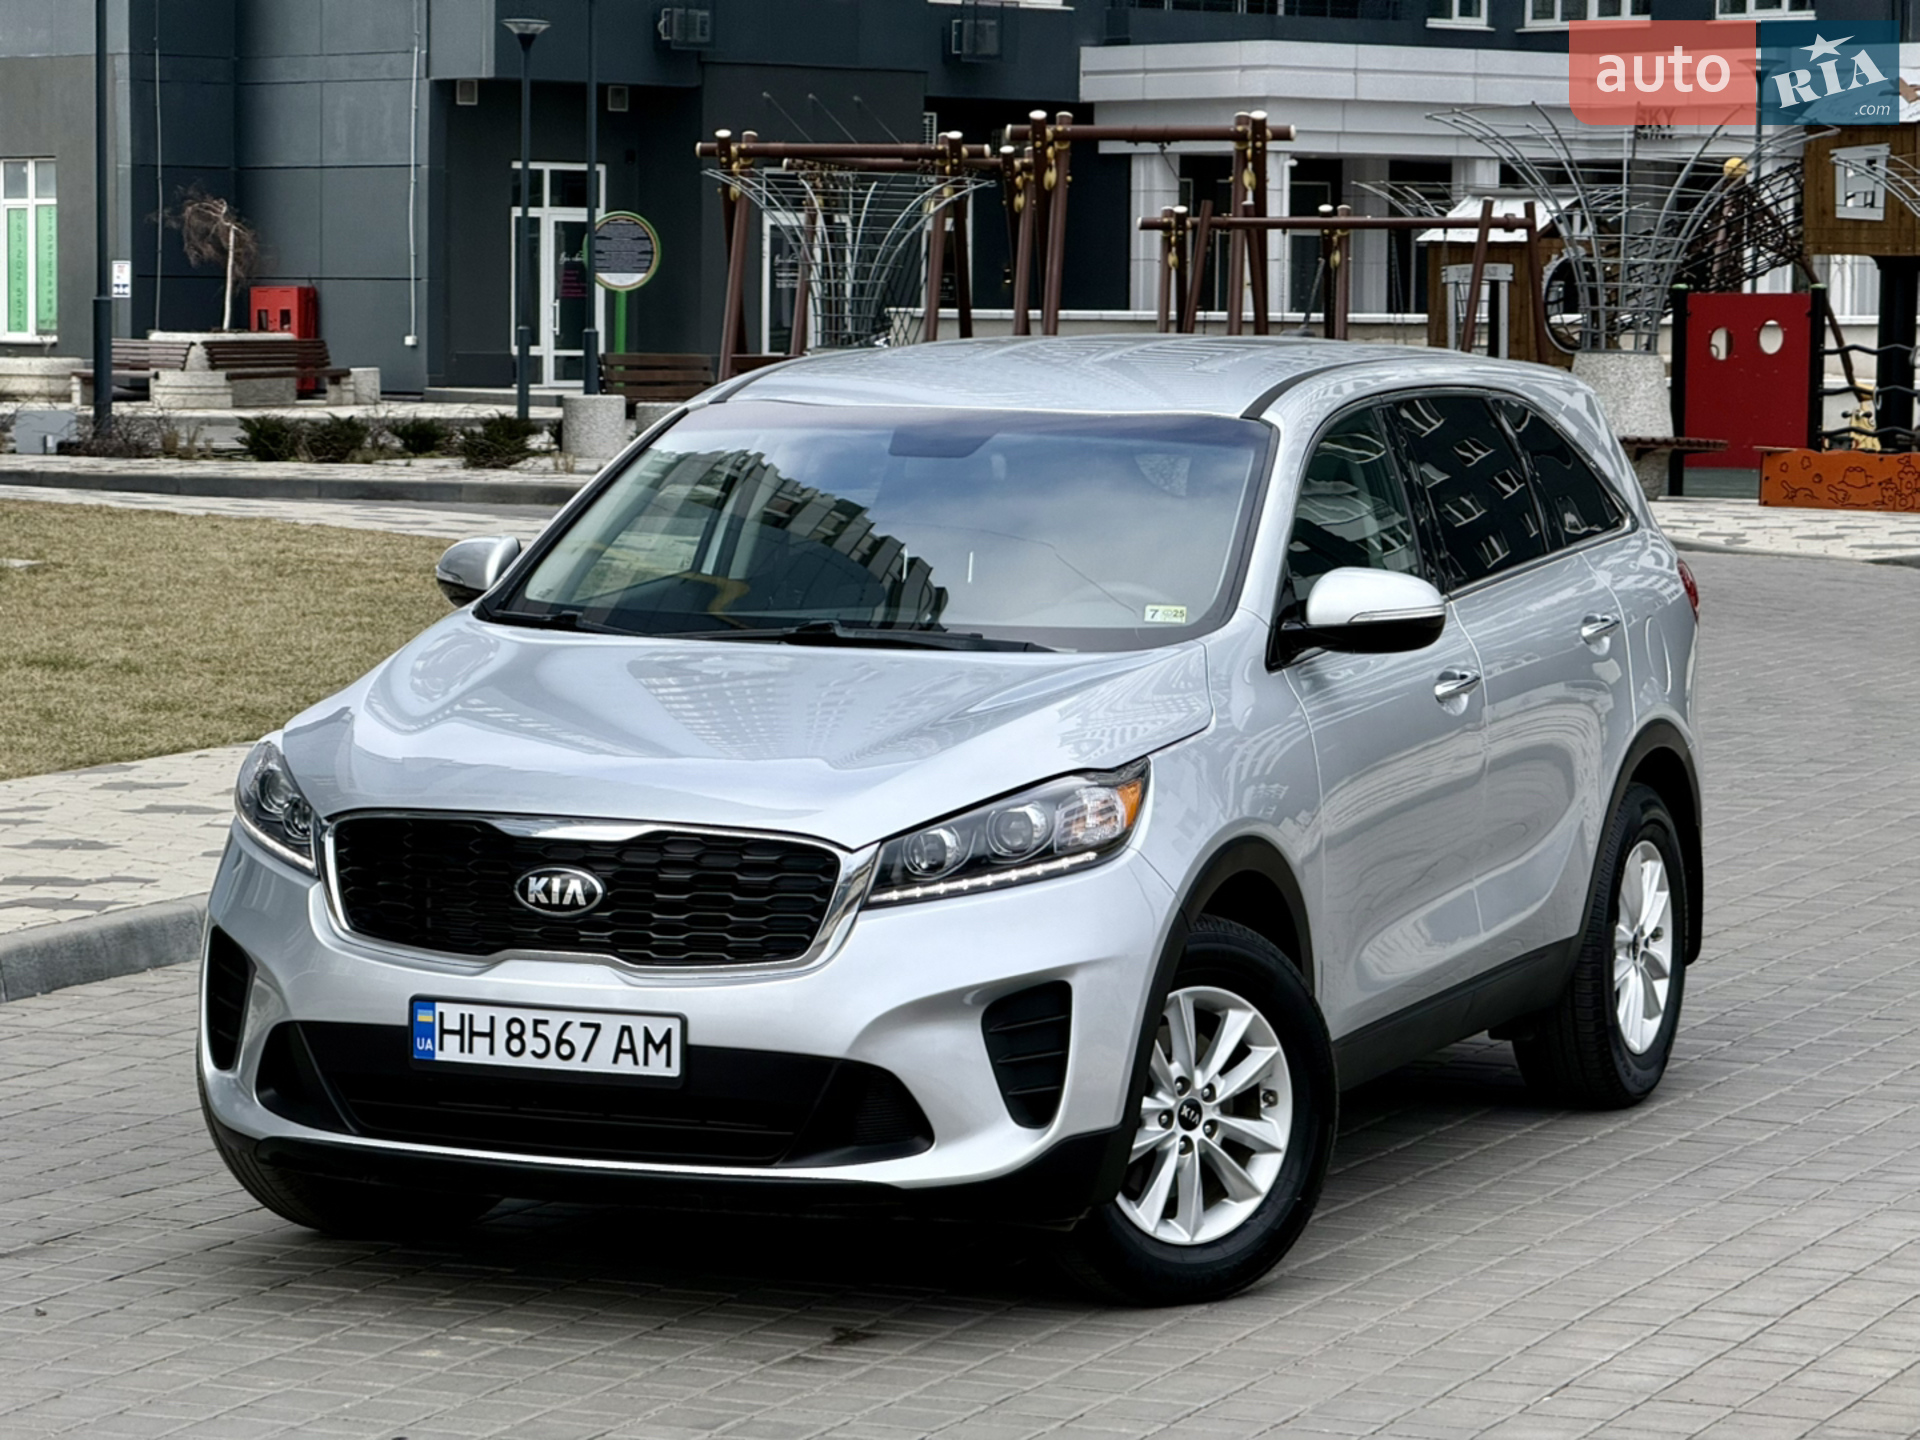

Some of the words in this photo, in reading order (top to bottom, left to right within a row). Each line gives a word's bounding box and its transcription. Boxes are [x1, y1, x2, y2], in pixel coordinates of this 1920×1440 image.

[1635, 107, 1676, 129] SKY
[1149, 609, 1159, 619] 7
[527, 876, 586, 906] KIA
[416, 1036, 434, 1051] UA
[438, 1011, 495, 1056] HH
[504, 1017, 602, 1062] 8567
[612, 1025, 672, 1068] AM
[1180, 1104, 1201, 1125] KIA
